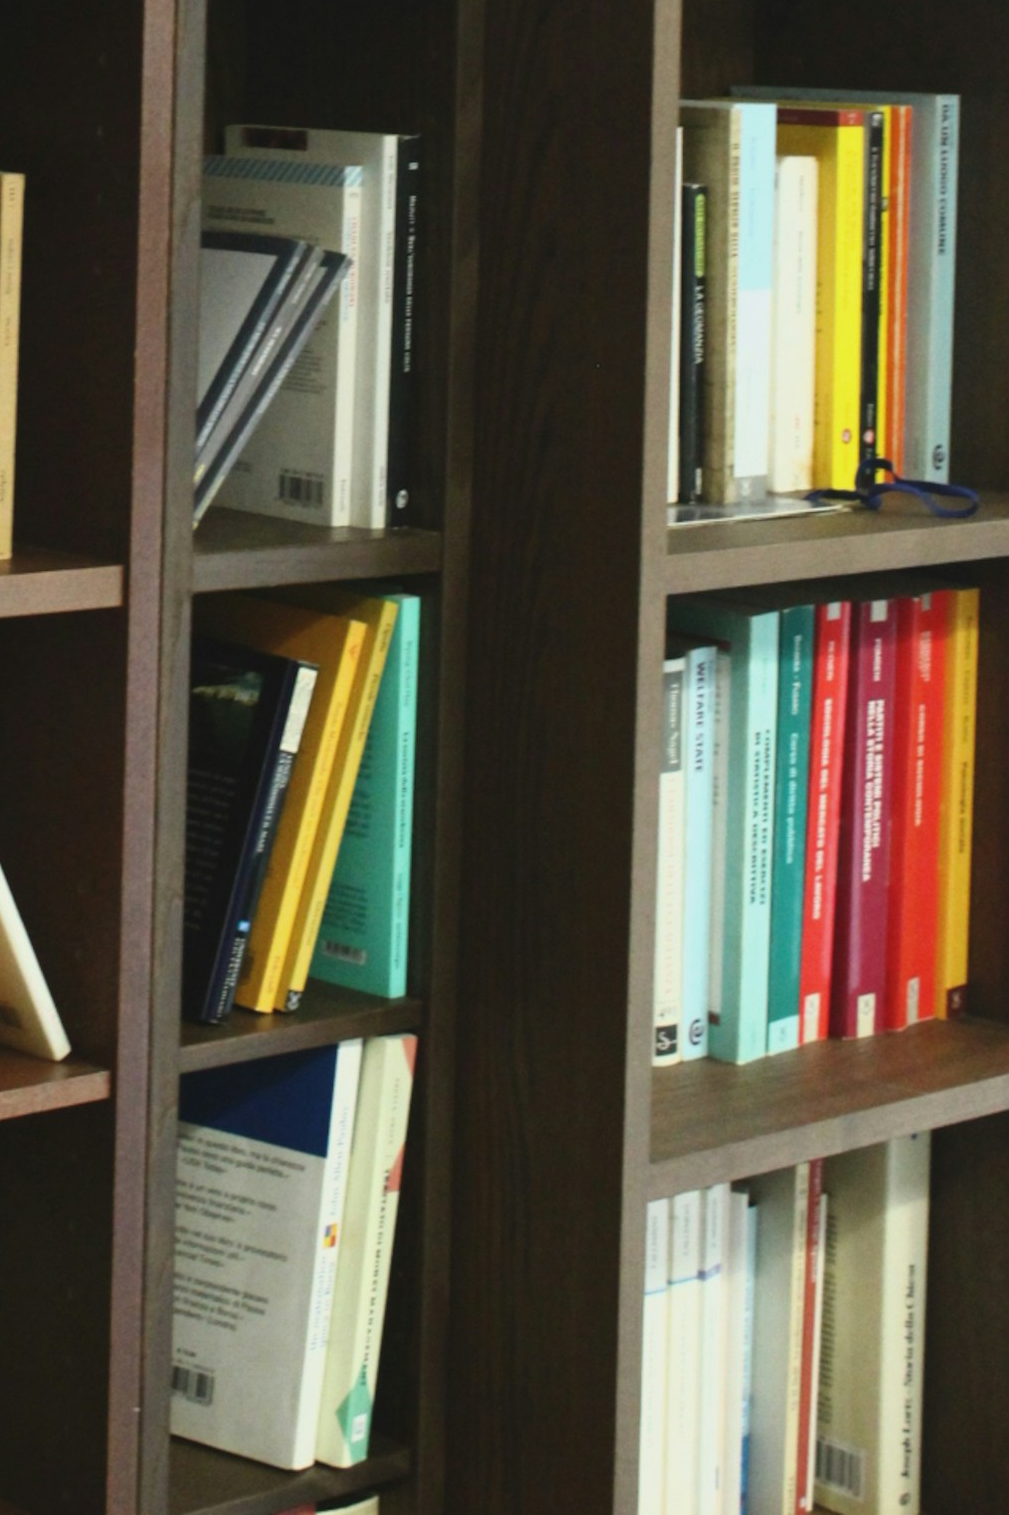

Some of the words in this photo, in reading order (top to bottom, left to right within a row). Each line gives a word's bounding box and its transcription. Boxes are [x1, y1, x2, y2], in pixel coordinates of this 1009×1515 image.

[938, 150, 949, 195] LUOGO
[936, 198, 947, 255] COMUNE
[668, 684, 680, 728] Thomas
[694, 661, 707, 727] WELFARE
[865, 699, 878, 739] NELLA
[873, 698, 886, 742] PARTITI
[665, 731, 679, 765] Nagel
[693, 733, 704, 772] STATE
[788, 732, 799, 766] Corso
[864, 739, 876, 780] STORIA
[818, 768, 829, 792] DEL
[871, 753, 884, 798] SISTEMI
[786, 780, 798, 815] diritto
[814, 849, 824, 874] DEL
[811, 875, 823, 920] LAVORO
[330, 1149, 344, 1181] Allen
[904, 1311, 914, 1344] della
[902, 1345, 913, 1387] Storia
[899, 1437, 912, 1478] Joseph
